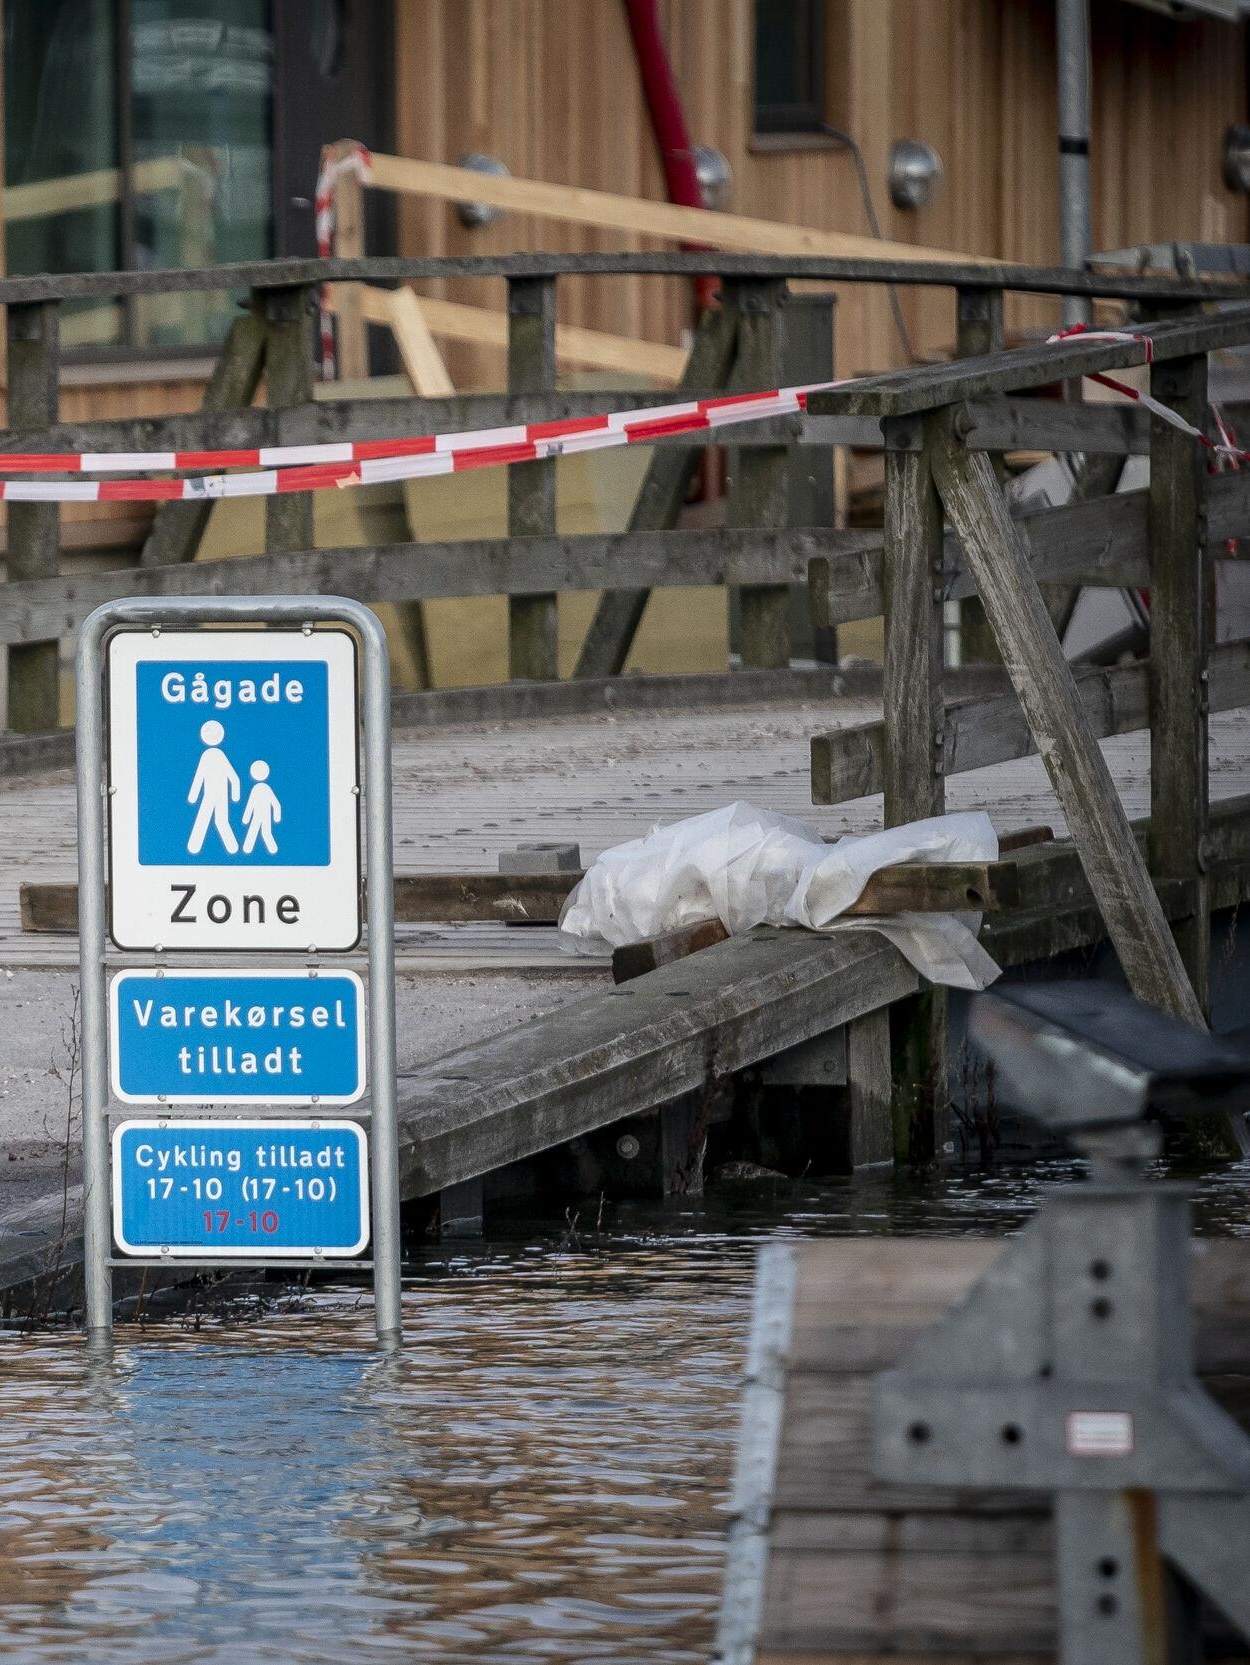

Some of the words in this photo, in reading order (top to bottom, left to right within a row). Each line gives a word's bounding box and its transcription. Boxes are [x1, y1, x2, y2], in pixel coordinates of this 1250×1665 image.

[161, 671, 304, 709] Gågade
[170, 883, 301, 925] Zone
[133, 999, 347, 1028] Varekørsel
[178, 1046, 303, 1074] tilladt
[135, 1144, 241, 1172] Cykling
[255, 1145, 346, 1168] tilladt
[147, 1176, 223, 1200] 17-10
[241, 1175, 337, 1202] (17-10)
[202, 1210, 279, 1233] 17-10
